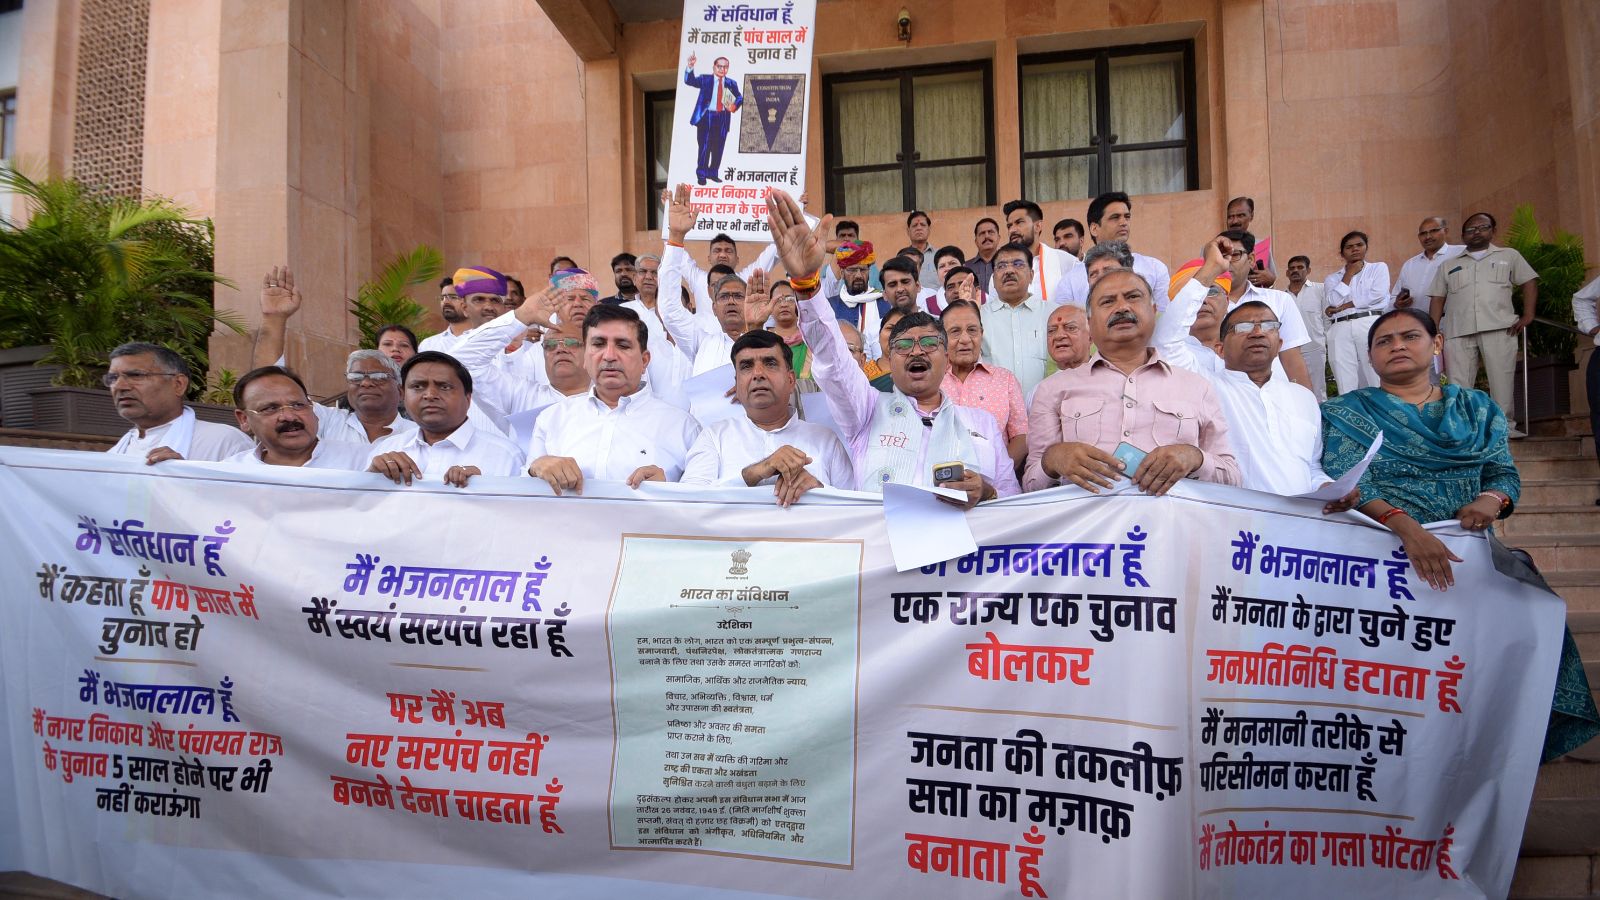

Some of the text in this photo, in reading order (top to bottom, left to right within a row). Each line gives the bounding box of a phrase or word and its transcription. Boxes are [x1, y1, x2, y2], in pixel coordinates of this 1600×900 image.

[688, 25, 808, 46] मैं कहता हूँ पांच साल में
[704, 1, 794, 24] मैं संविधान हूँ
[747, 45, 798, 64] चुनाव हो
[695, 188, 719, 198] नगर
[720, 185, 756, 199] निकाय
[724, 166, 798, 186] मैं भजनलाल हूँ
[698, 218, 714, 230] होने
[716, 220, 728, 231] पर
[730, 218, 742, 231] भी
[743, 220, 762, 232] नहीं
[716, 204, 737, 214] राज
[738, 201, 749, 214] के
[75, 515, 236, 576] मैं संविधान हूँ
[1120, 524, 1150, 588] हूँ
[1230, 530, 1260, 575] मैं
[1260, 544, 1378, 589] भजनलाल
[36, 563, 259, 620] मैं कहता हूँ पांच साल में
[343, 553, 552, 612] मैं भजनलाल हूँ
[680, 586, 790, 602] भारत का संविधान
[98, 614, 204, 655] चुनाव हो
[302, 597, 574, 658] मैं स्वयं सरपंच रहा हूँ
[716, 620, 752, 630] उद्देशिका
[890, 592, 1177, 642] एक राज्य एक चुनाव
[1211, 585, 1456, 652] मैं जनता के द्वारा चुने हुए
[666, 676, 702, 684] सामाजिक,
[705, 676, 730, 684] आर्थिक
[733, 676, 746, 684] और
[706, 658, 726, 668] उसके
[753, 660, 786, 668] नागरिकों
[965, 631, 1094, 686] बोलकर
[1206, 642, 1466, 714] जनप्रतिनिधि हटाता हूँ
[78, 669, 240, 722] मैं भजनलाल हूँ
[386, 688, 506, 728] पर मैं अब
[32, 708, 284, 756] मैं नगर निकाय और पंचायत राज
[667, 720, 766, 734] प्रतिष्ठा और अवसर की समता
[667, 732, 733, 744] प्राप्त कराने के लिए,
[1200, 708, 1407, 756] मैं मनमानी तरीके से
[42, 741, 274, 793] के चुनाव 5 साल होने पर भी
[346, 729, 549, 776] नए सरपंच नहीं
[907, 728, 1184, 802] जनता की तकलीफ़
[1200, 751, 1378, 802] परिसीमन करता हूँ
[96, 783, 201, 819] नहीं कराऊंगा
[330, 774, 565, 834] बनने देना चाहता हूँ
[906, 778, 972, 818] सत्ता
[976, 784, 1021, 822] का
[904, 825, 1048, 899] बनाता हूँ
[1200, 820, 1460, 880] मैं लोकतंत्र का गला घोंटता हूँ
